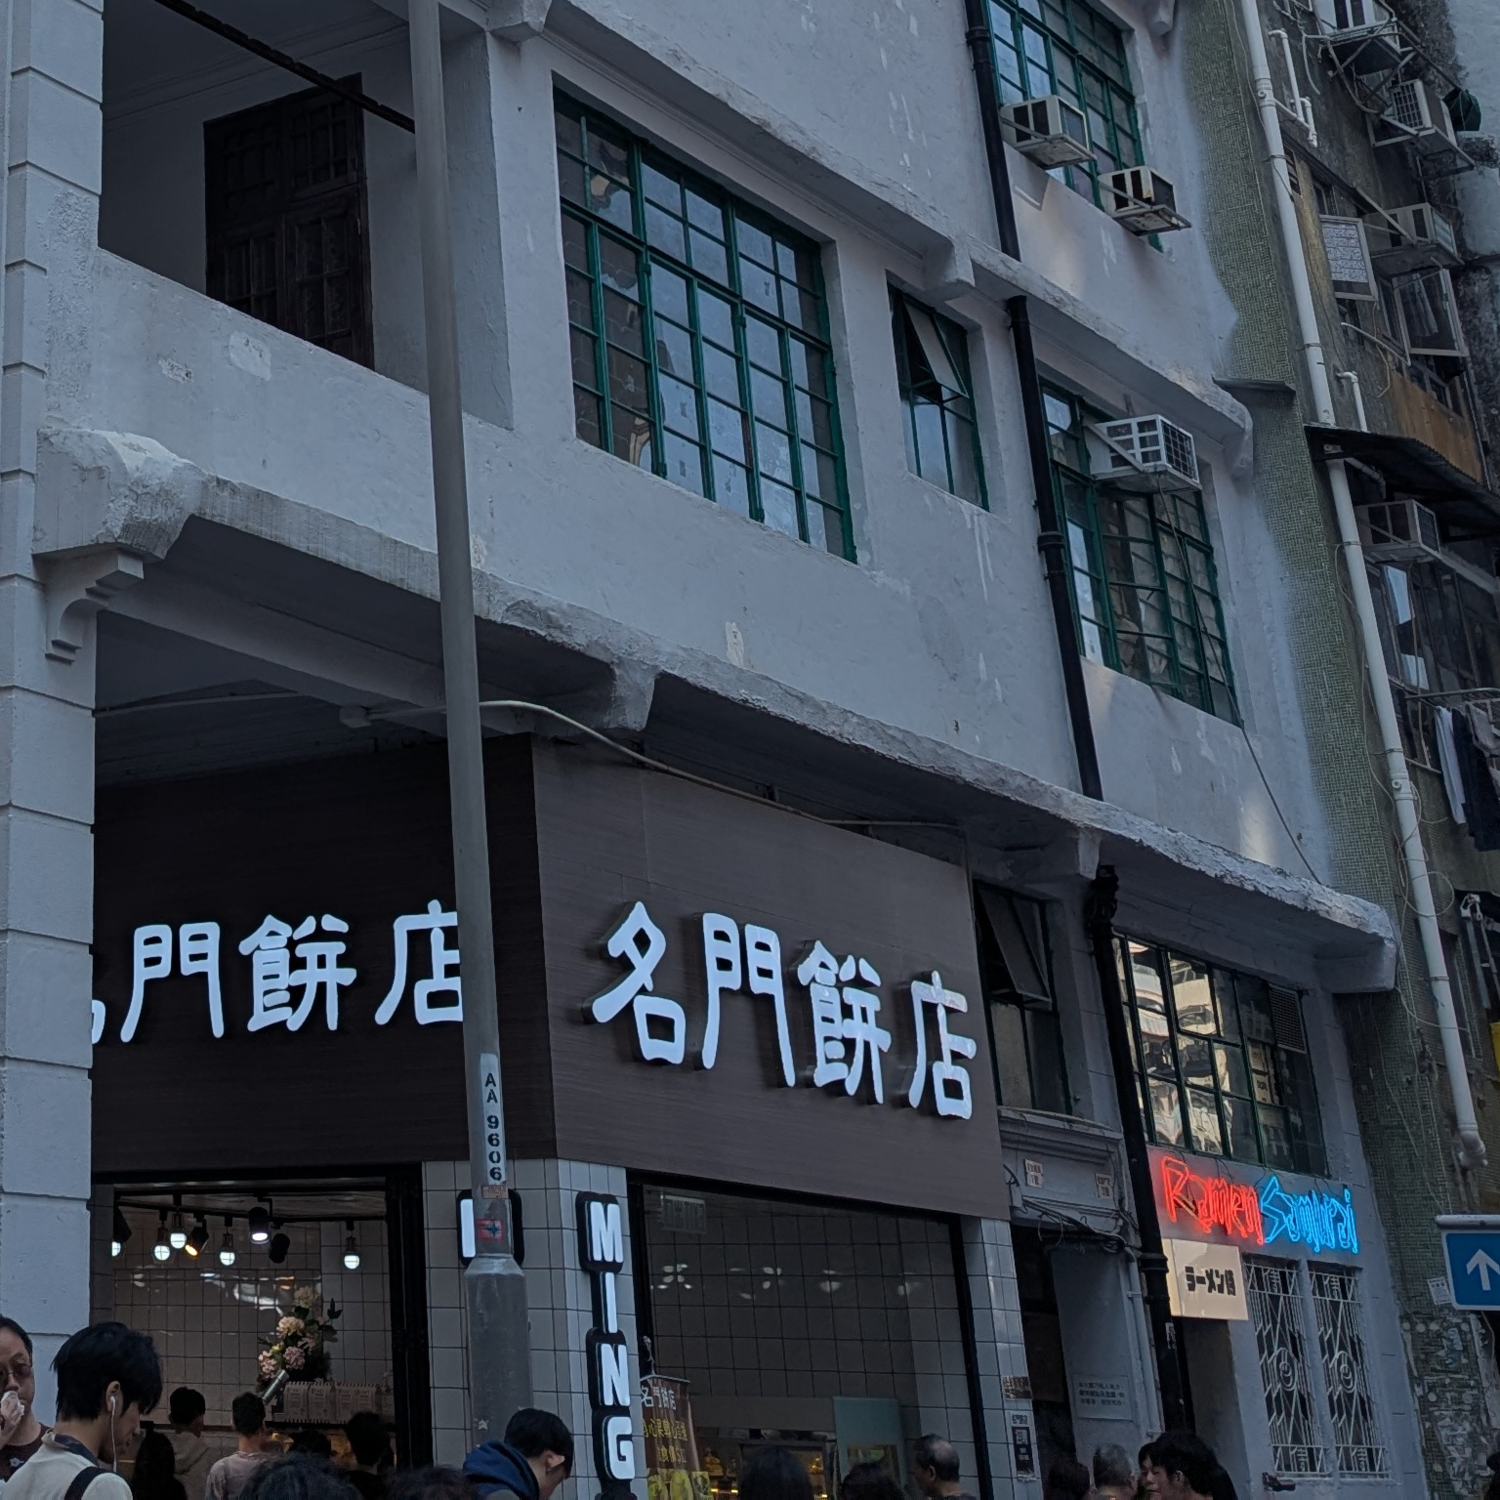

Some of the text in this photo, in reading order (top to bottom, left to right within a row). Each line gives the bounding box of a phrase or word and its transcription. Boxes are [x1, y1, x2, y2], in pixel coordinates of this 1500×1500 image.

[92, 901, 463, 1043] 門餅店
[592, 901, 977, 1120] 名門餅店
[484, 1072, 498, 1103] AA
[486, 1115, 502, 1181] 9606
[1160, 1155, 1359, 1254] Ramen Samurai
[589, 1201, 636, 1481] MING
